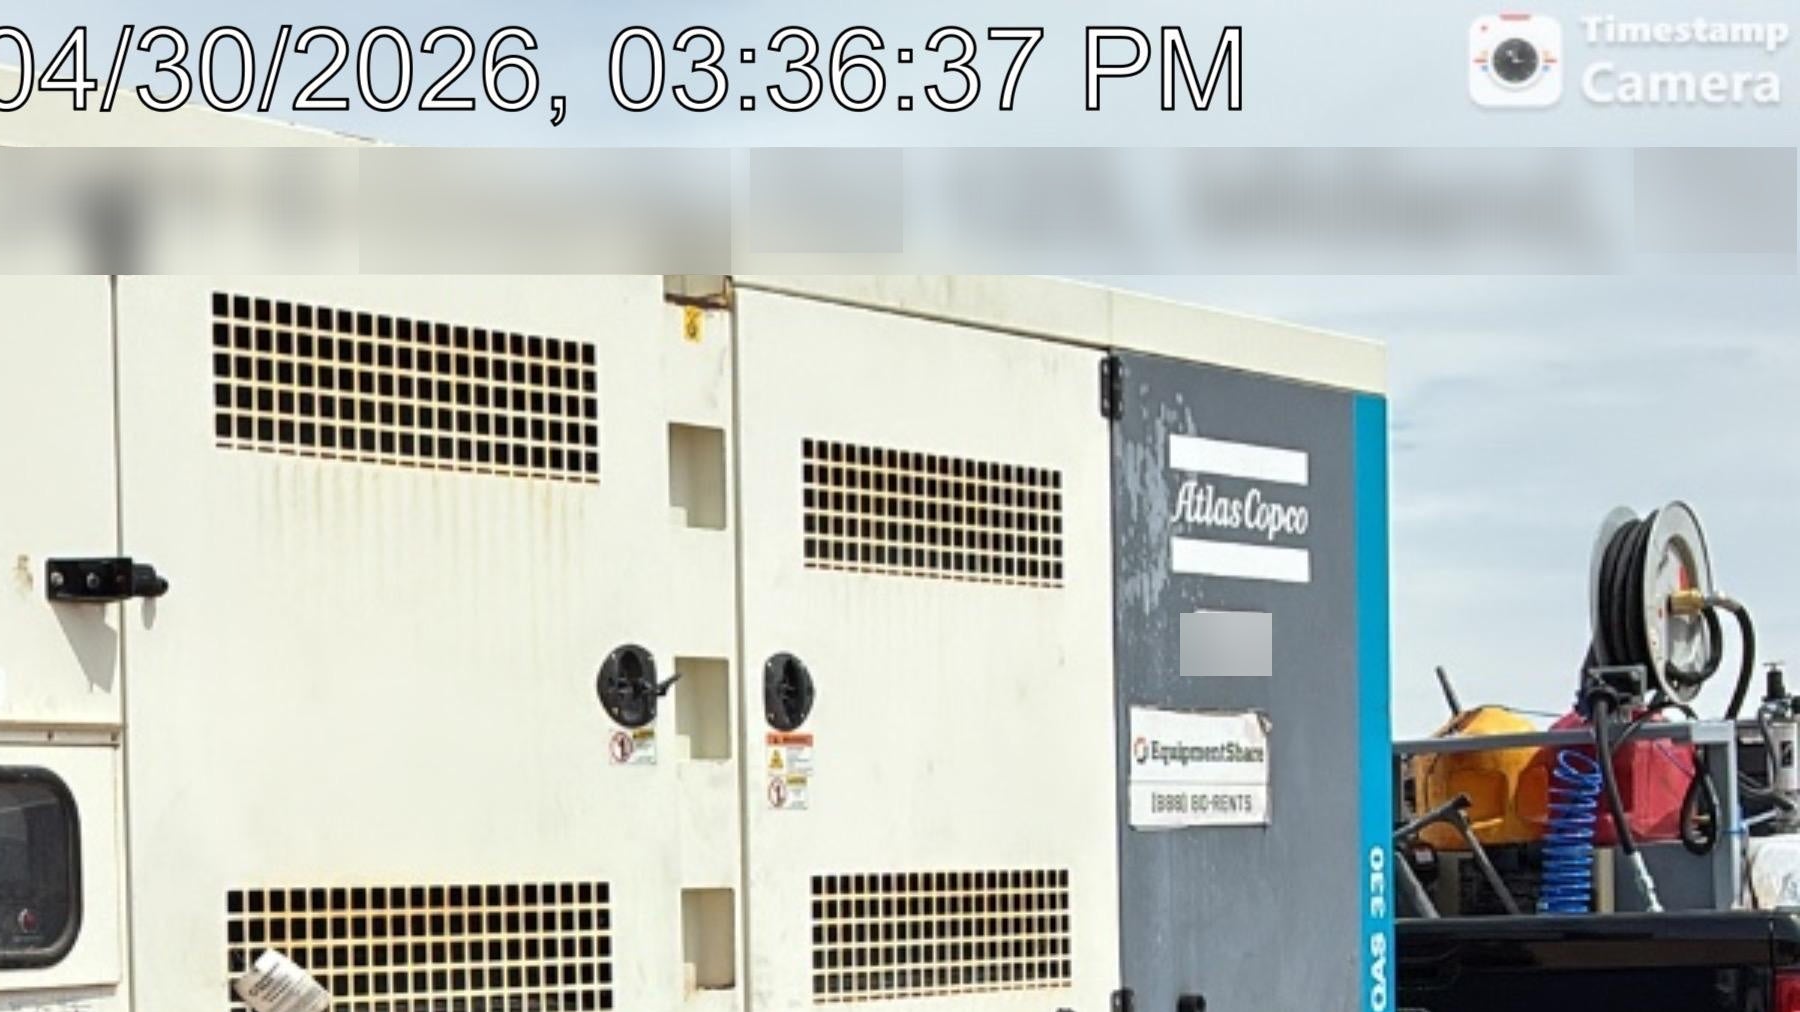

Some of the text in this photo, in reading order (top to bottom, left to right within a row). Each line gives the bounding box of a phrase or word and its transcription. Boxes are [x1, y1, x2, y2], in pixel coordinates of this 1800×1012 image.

[1170, 480, 1309, 541] Atlas Copco
[1151, 740, 1264, 766] EquipmentShare
[1370, 845, 1387, 1012] QAS 330
